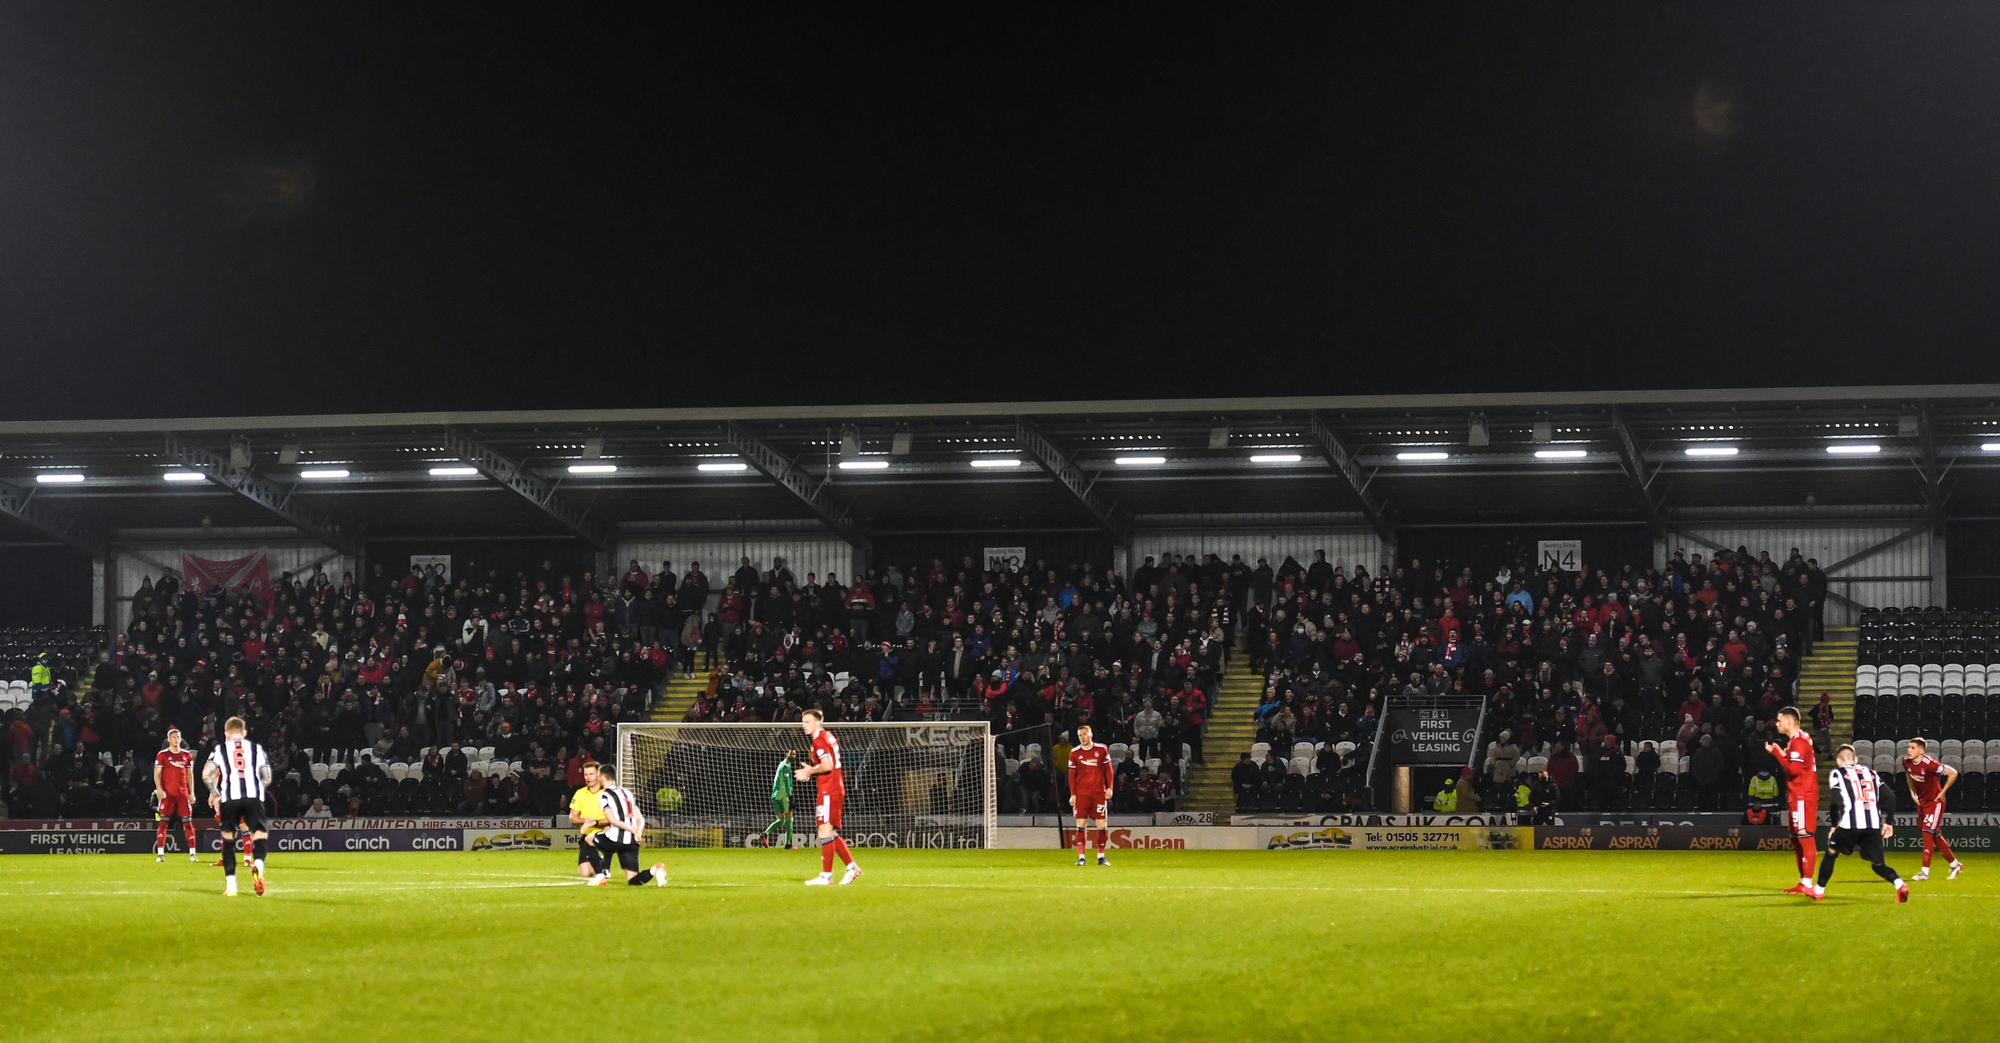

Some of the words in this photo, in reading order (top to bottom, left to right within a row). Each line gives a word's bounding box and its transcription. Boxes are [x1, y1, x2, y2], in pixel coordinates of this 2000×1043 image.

[1544, 550, 1576, 570] N4
[1420, 720, 1452, 729] FIRST
[1411, 731, 1460, 741] VEHICLE
[1412, 743, 1460, 752] LEASING
[233, 749, 246, 770] 6
[1852, 780, 1876, 802] 12
[422, 820, 447, 829] HIRE
[456, 820, 490, 829] SALES
[500, 819, 545, 829] SERVICE
[1199, 812, 1213, 824] 28
[30, 833, 66, 845] FIRST
[69, 833, 126, 845] VEHICLE
[278, 833, 323, 850] cinch
[345, 833, 390, 850] cinch
[412, 832, 457, 850] cinch
[950, 831, 979, 849] Ltd
[1365, 832, 1383, 842] Tel:
[1386, 832, 1419, 842] 01505
[1423, 832, 1460, 842] 327711
[1543, 836, 1594, 849] ASPRAY
[1608, 836, 1660, 849] ASPRAY
[1689, 836, 1741, 849] ASPRAY
[1948, 834, 1991, 848] waste
